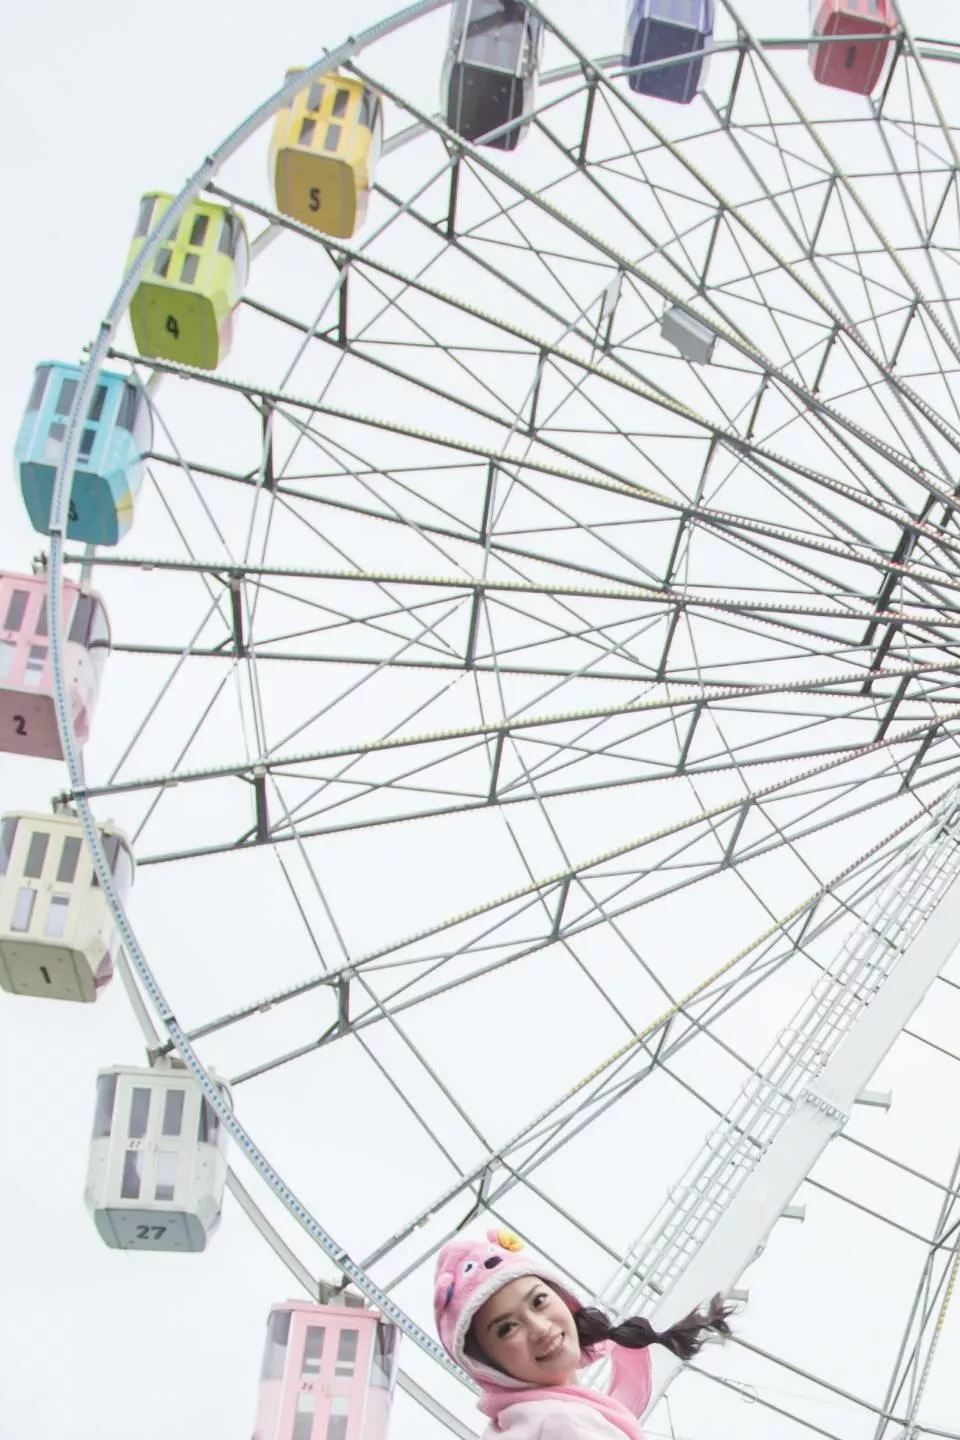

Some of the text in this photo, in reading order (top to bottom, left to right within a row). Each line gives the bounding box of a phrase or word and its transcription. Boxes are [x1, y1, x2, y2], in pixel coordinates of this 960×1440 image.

[309, 187, 321, 212] 5
[165, 314, 180, 341] 4
[13, 715, 28, 736] 2
[39, 966, 51, 985] 1
[136, 1225, 167, 1241] 27
